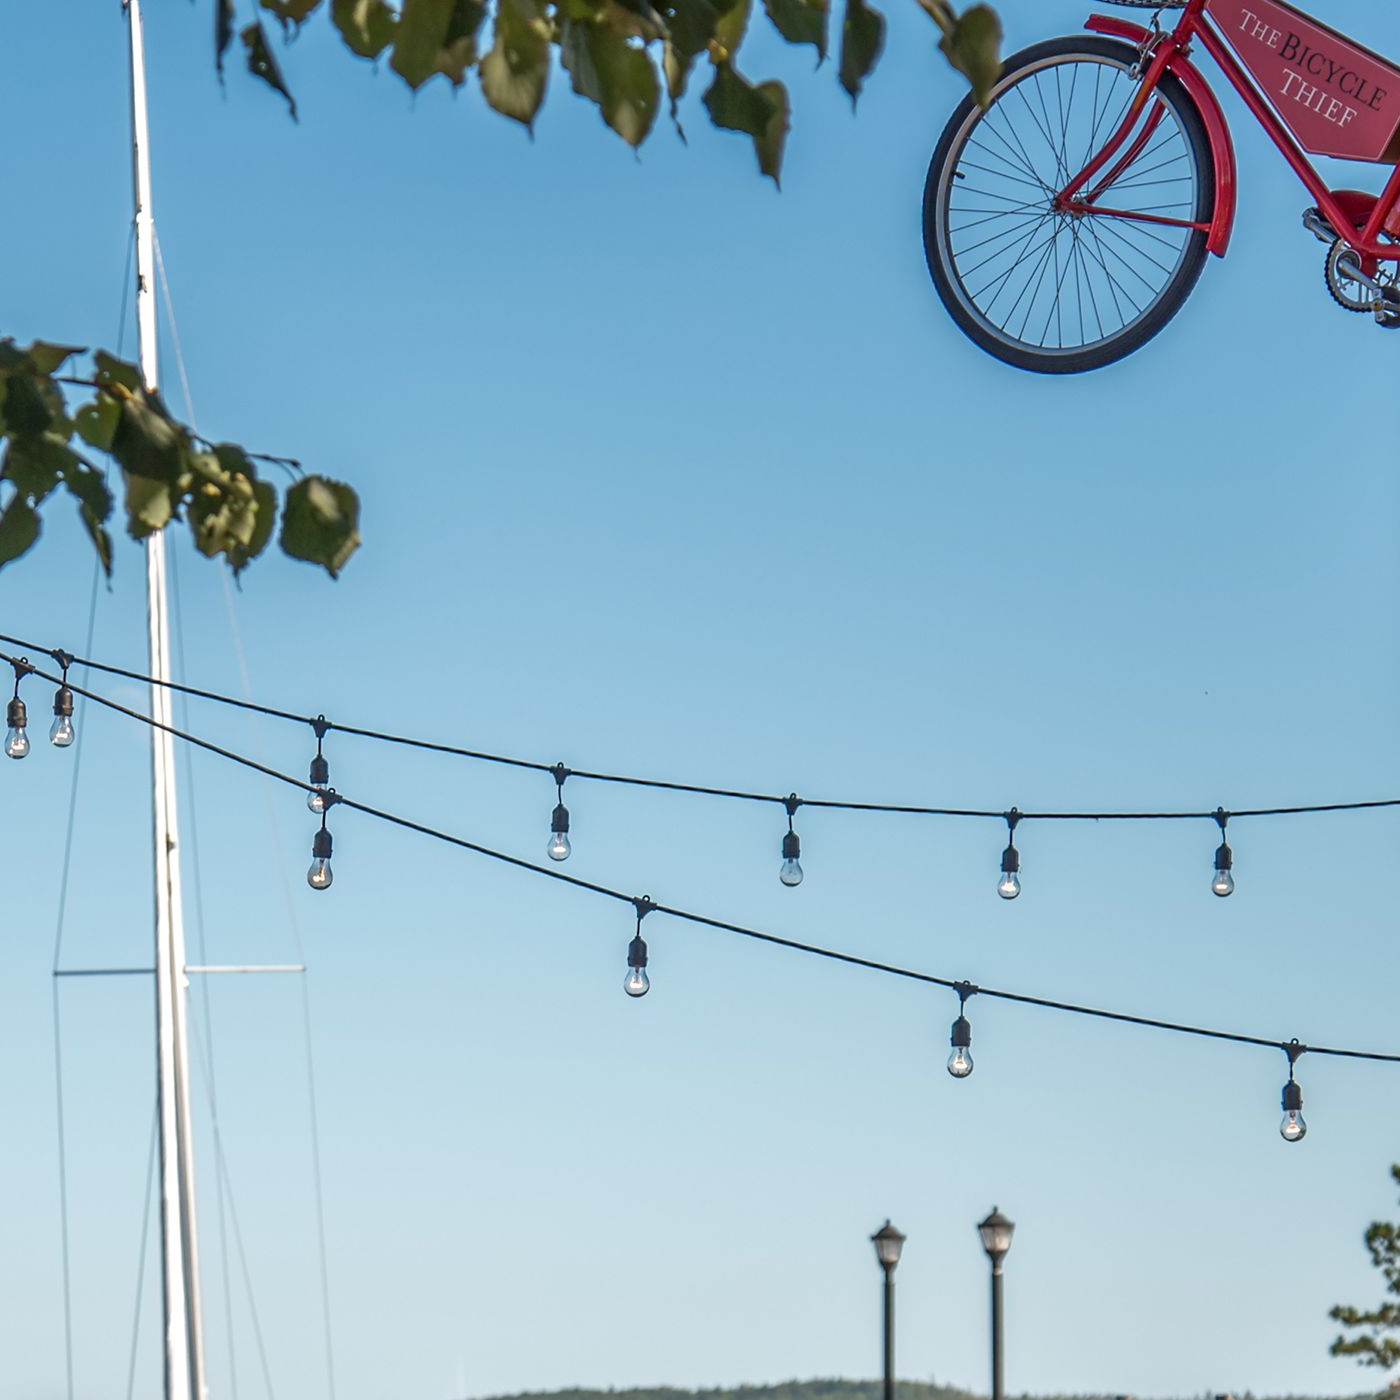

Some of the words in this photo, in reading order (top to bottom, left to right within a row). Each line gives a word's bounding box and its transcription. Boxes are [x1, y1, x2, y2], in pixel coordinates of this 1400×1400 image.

[1239, 8, 1282, 49] THE
[1278, 31, 1388, 112] BICYCLE
[1279, 68, 1358, 128] THIEF
